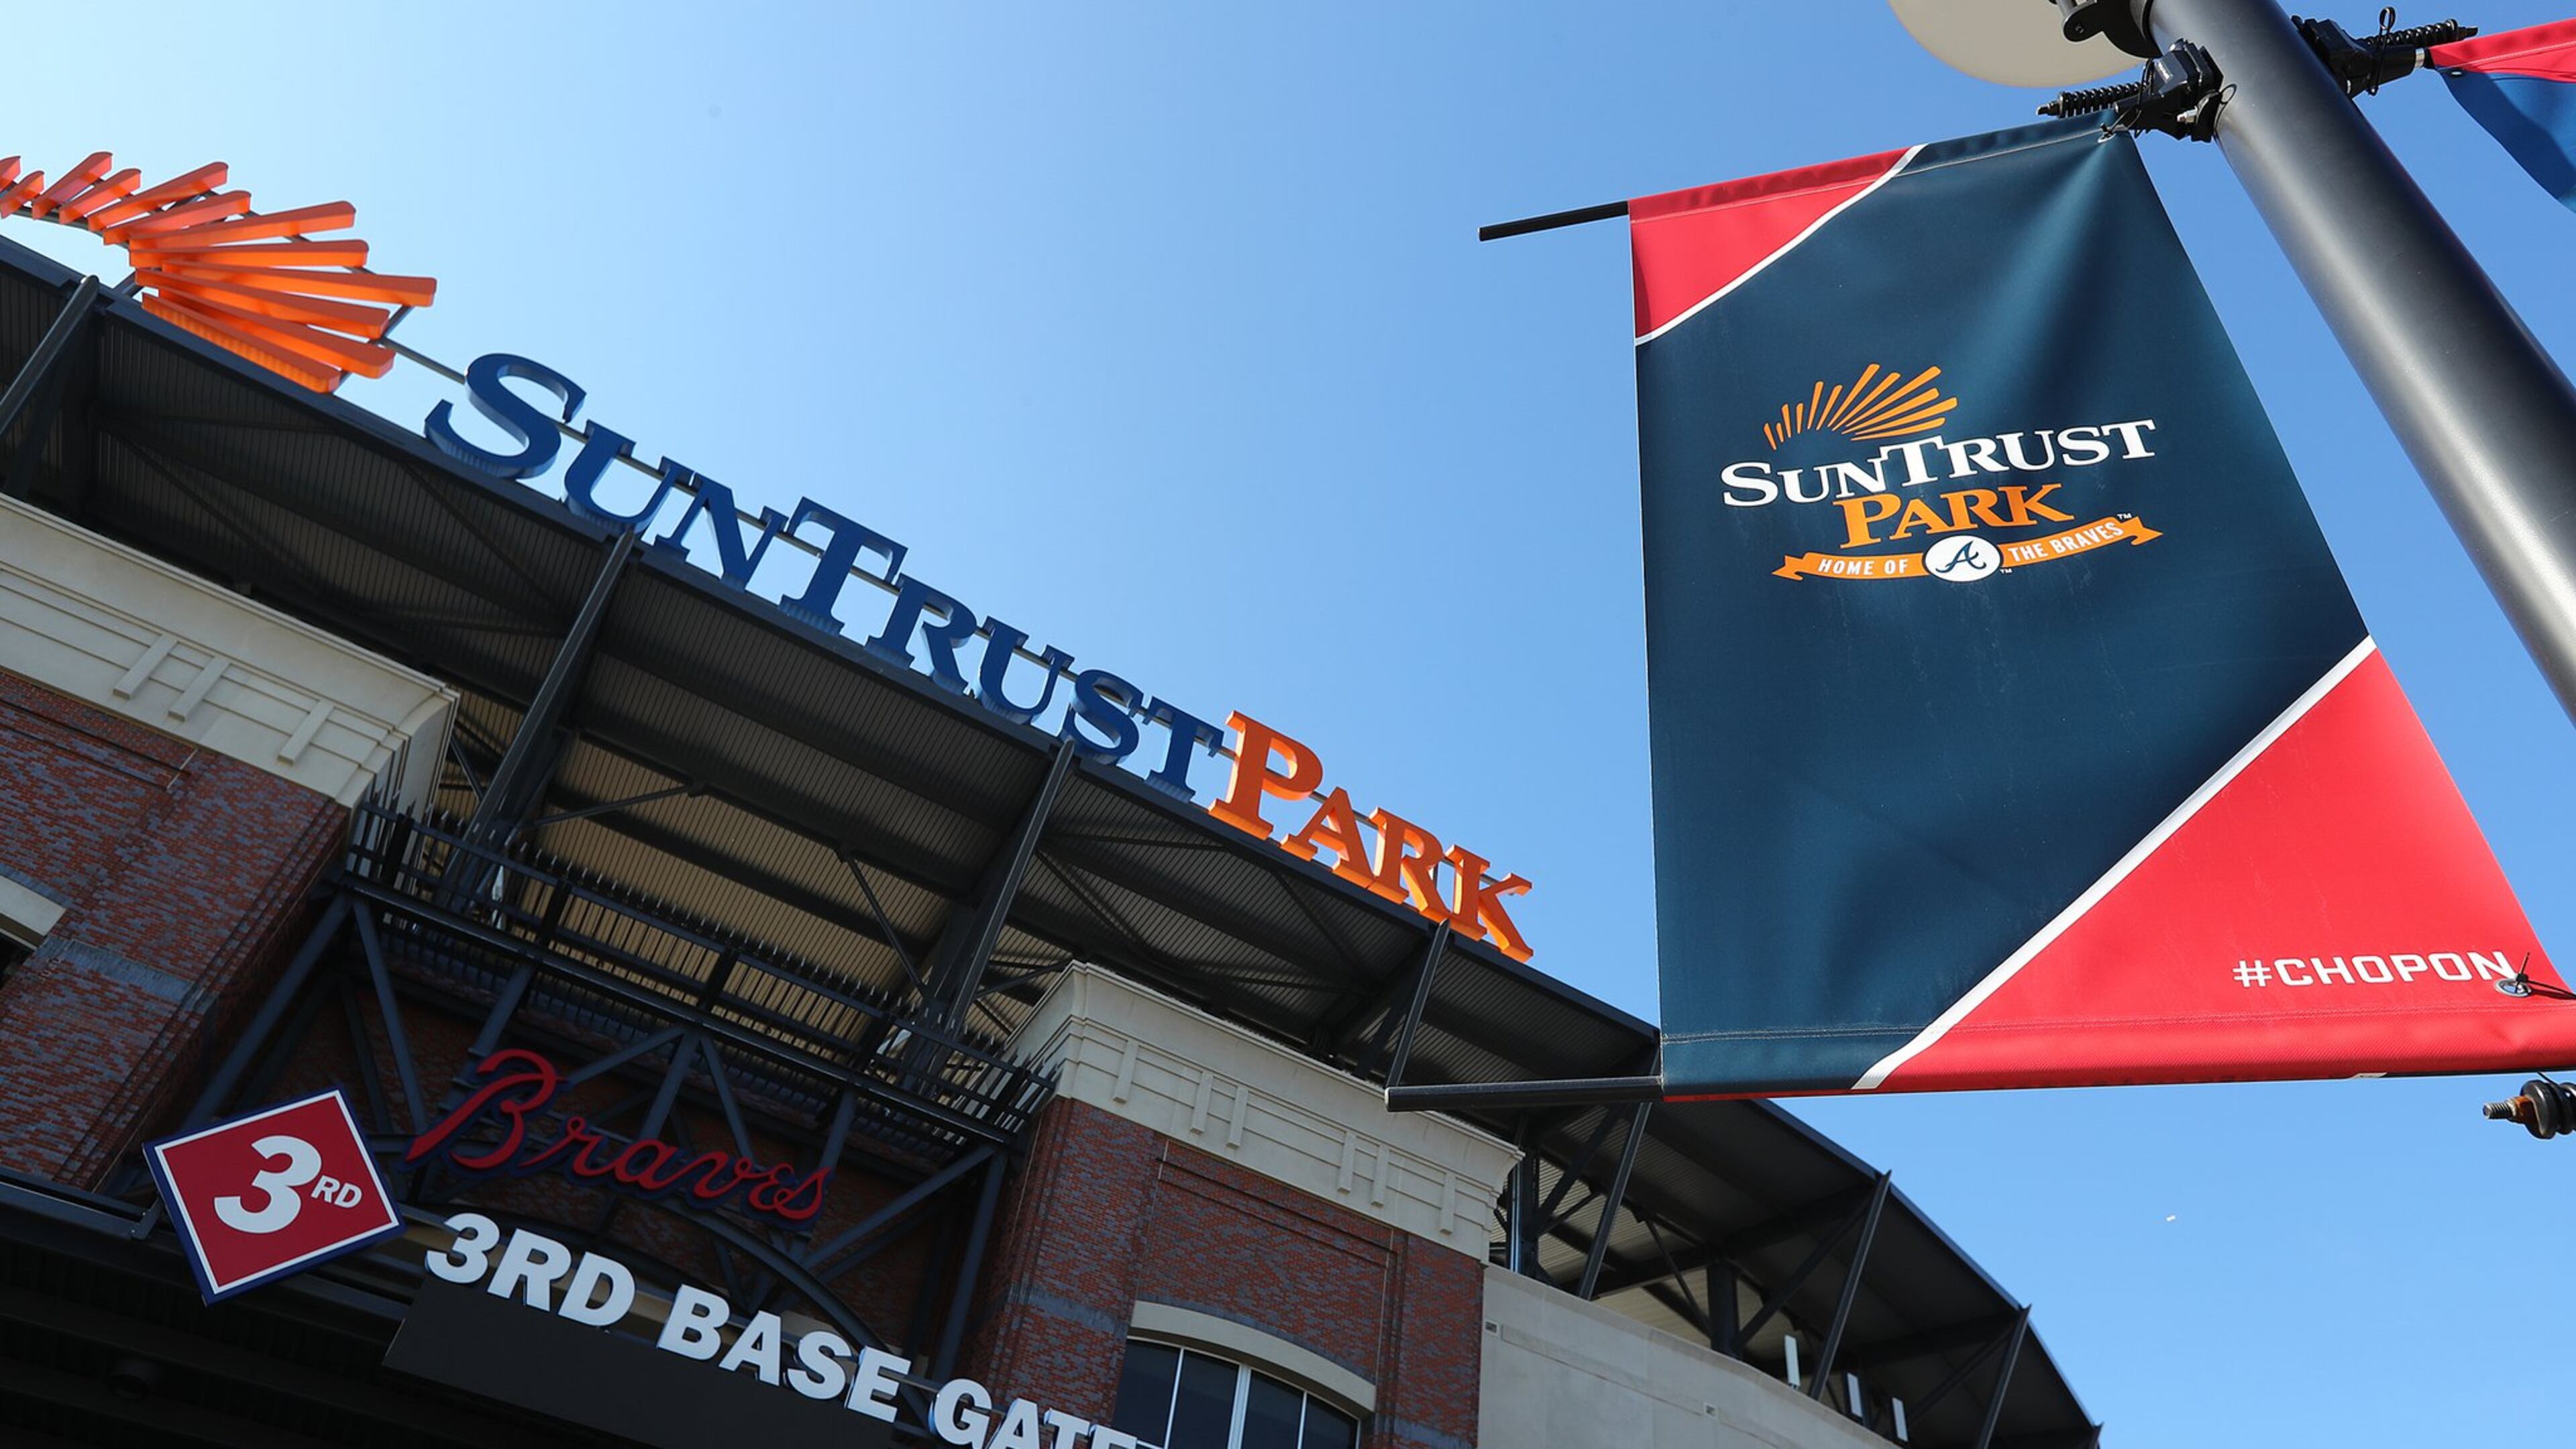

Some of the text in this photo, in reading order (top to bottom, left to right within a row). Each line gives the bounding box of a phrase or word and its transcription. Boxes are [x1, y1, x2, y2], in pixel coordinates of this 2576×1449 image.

[1720, 419, 2155, 506] SUNTRUST
[1818, 522, 2124, 575] HOME OF THE BRAVES
[1833, 483, 2074, 549] PARK
[424, 354, 1534, 963] SUNTRUST PARK
[2233, 951, 2517, 987] #CHOPON
[407, 1049, 833, 1220] Braves
[425, 1213, 636, 1327] 3RD
[657, 1284, 911, 1423] BASE
